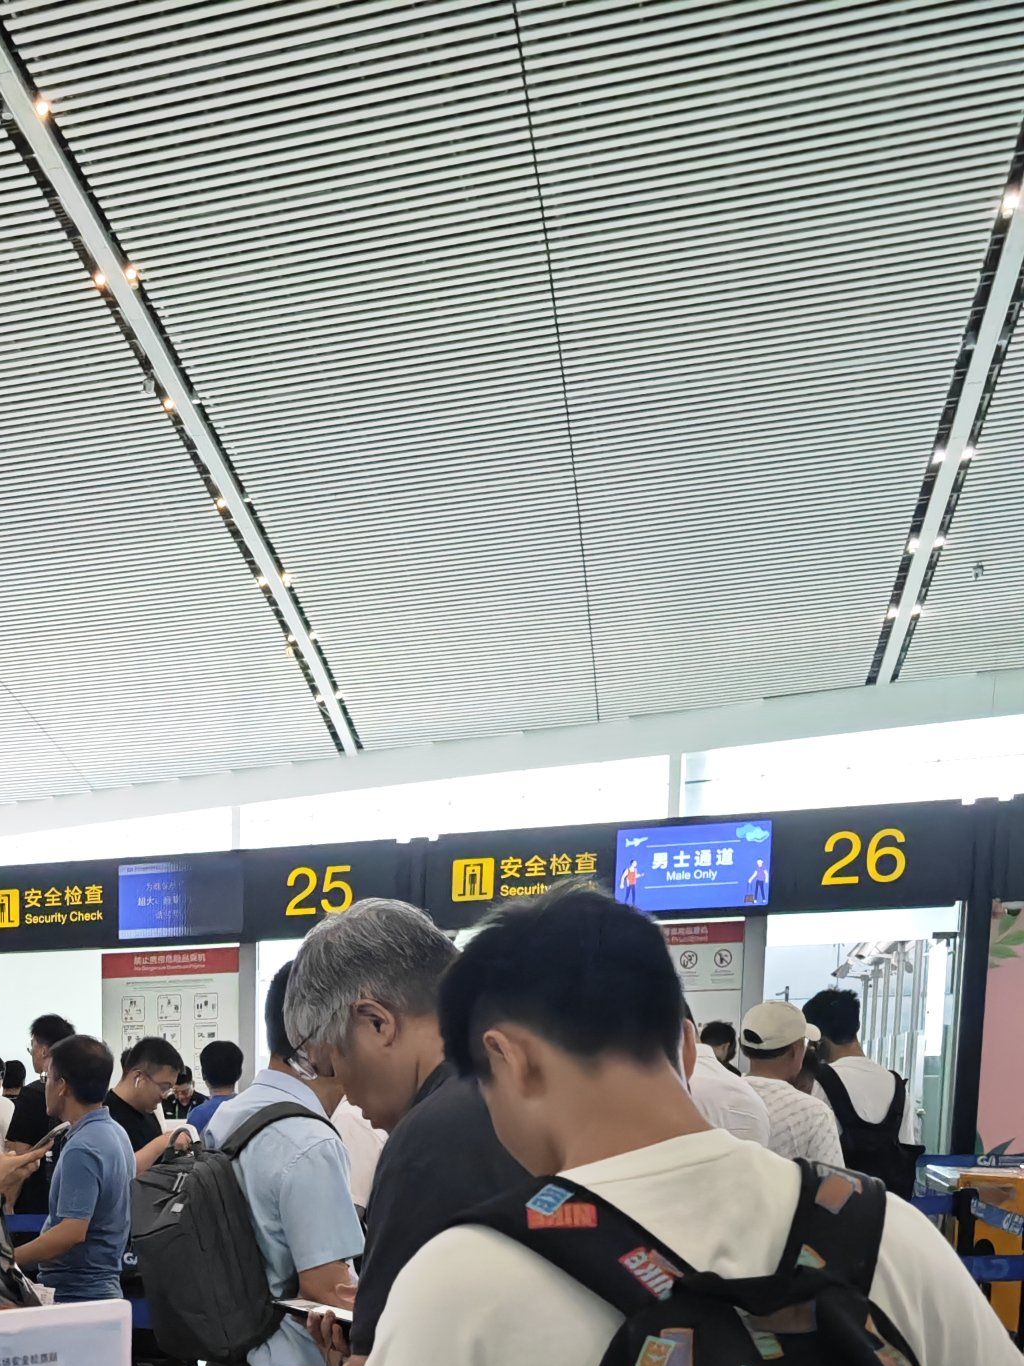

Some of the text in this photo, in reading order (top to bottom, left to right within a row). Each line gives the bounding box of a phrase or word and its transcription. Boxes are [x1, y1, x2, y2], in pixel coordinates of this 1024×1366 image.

[500, 852, 598, 879] 安全检查
[651, 848, 735, 869] 男士通道
[821, 828, 907, 887] 26
[666, 869, 718, 884] Male Only
[24, 884, 104, 908] 安全检查
[284, 865, 354, 916] 25
[500, 881, 551, 897] Security
[24, 908, 104, 927] Security Check
